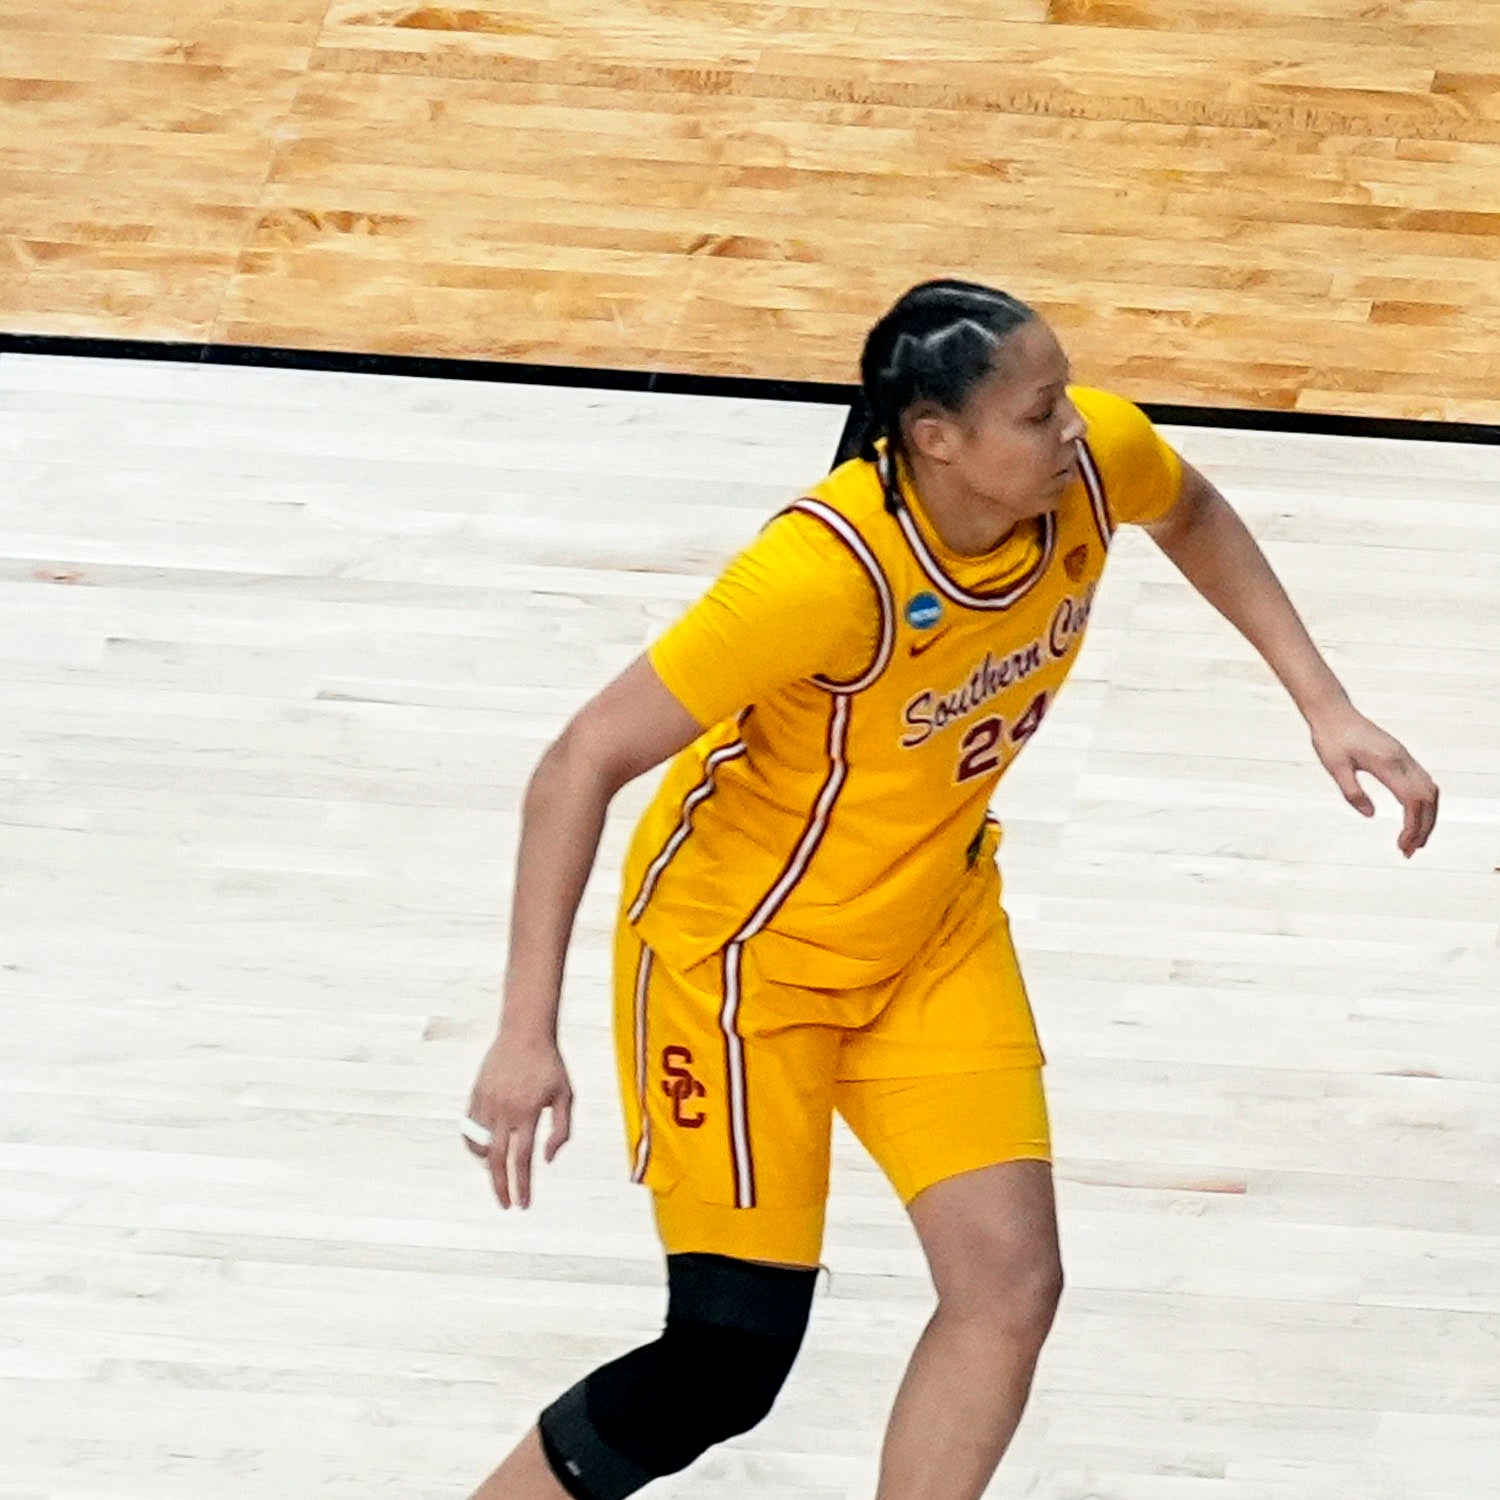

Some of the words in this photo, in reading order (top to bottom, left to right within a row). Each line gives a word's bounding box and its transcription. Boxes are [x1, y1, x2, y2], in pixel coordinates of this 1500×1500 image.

[902, 642, 1041, 748] Southern
[955, 689, 1049, 783] 24
[661, 1045, 706, 1128] SC
